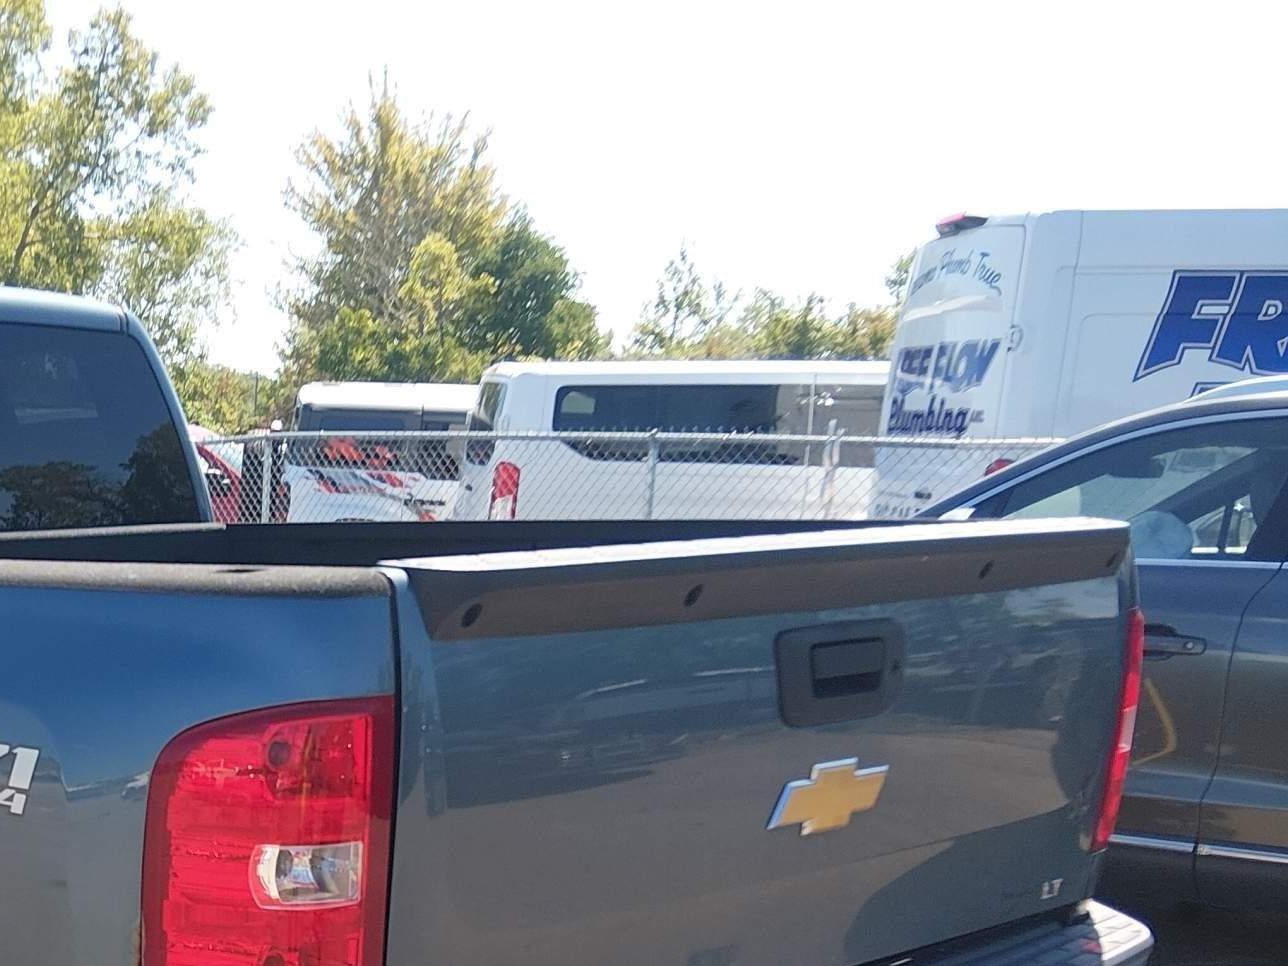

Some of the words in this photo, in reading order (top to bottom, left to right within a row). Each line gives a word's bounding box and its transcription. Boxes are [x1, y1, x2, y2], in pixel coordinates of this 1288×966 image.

[973, 252, 1002, 296] True
[927, 338, 1001, 393] FLOW
[887, 395, 970, 438] Plumbing
[1040, 878, 1064, 900] LT
